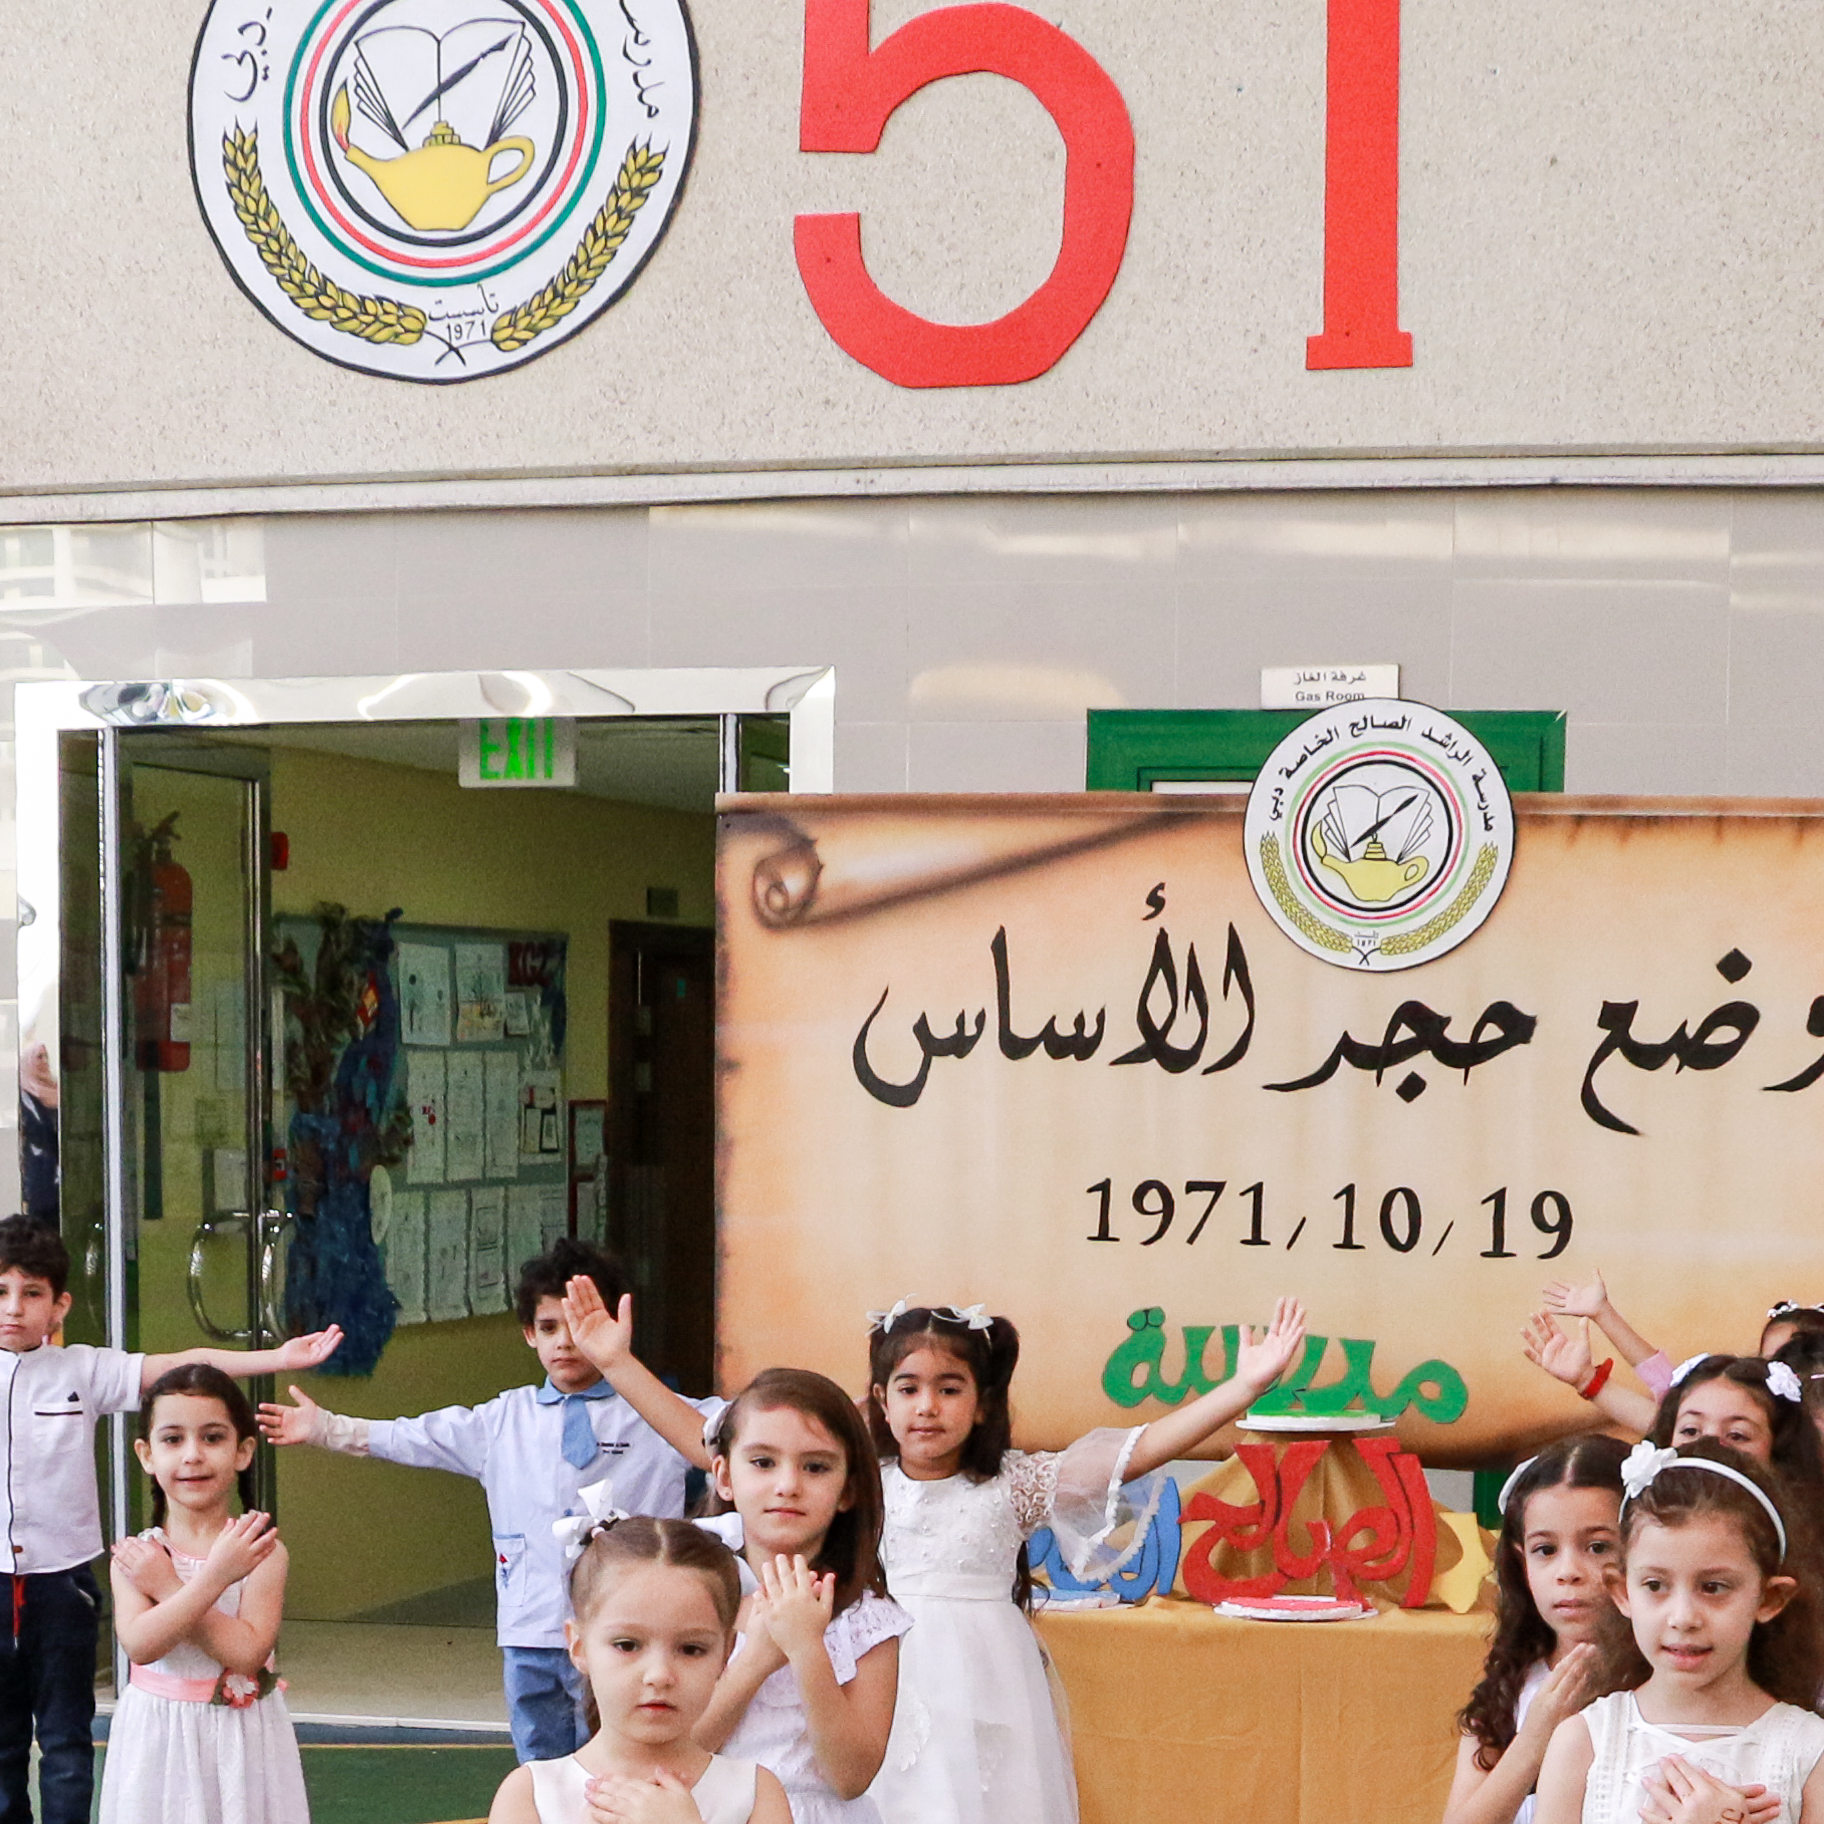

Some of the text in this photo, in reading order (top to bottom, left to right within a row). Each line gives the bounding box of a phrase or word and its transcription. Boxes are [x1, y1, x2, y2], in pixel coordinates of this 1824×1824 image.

[619, 0, 665, 118] مدرس
[793, 0, 1414, 389] 51
[446, 319, 486, 342] 1971
[1295, 691, 1365, 701] Gas Room
[1269, 714, 1495, 832] مدرسة الراشد الصالح الخاصة دبي
[853, 882, 1255, 1109] الأساس
[1262, 999, 1538, 1104] حجر
[1085, 1177, 1573, 1260] 1971/10/19
[1177, 1436, 1437, 1610] الصالح
